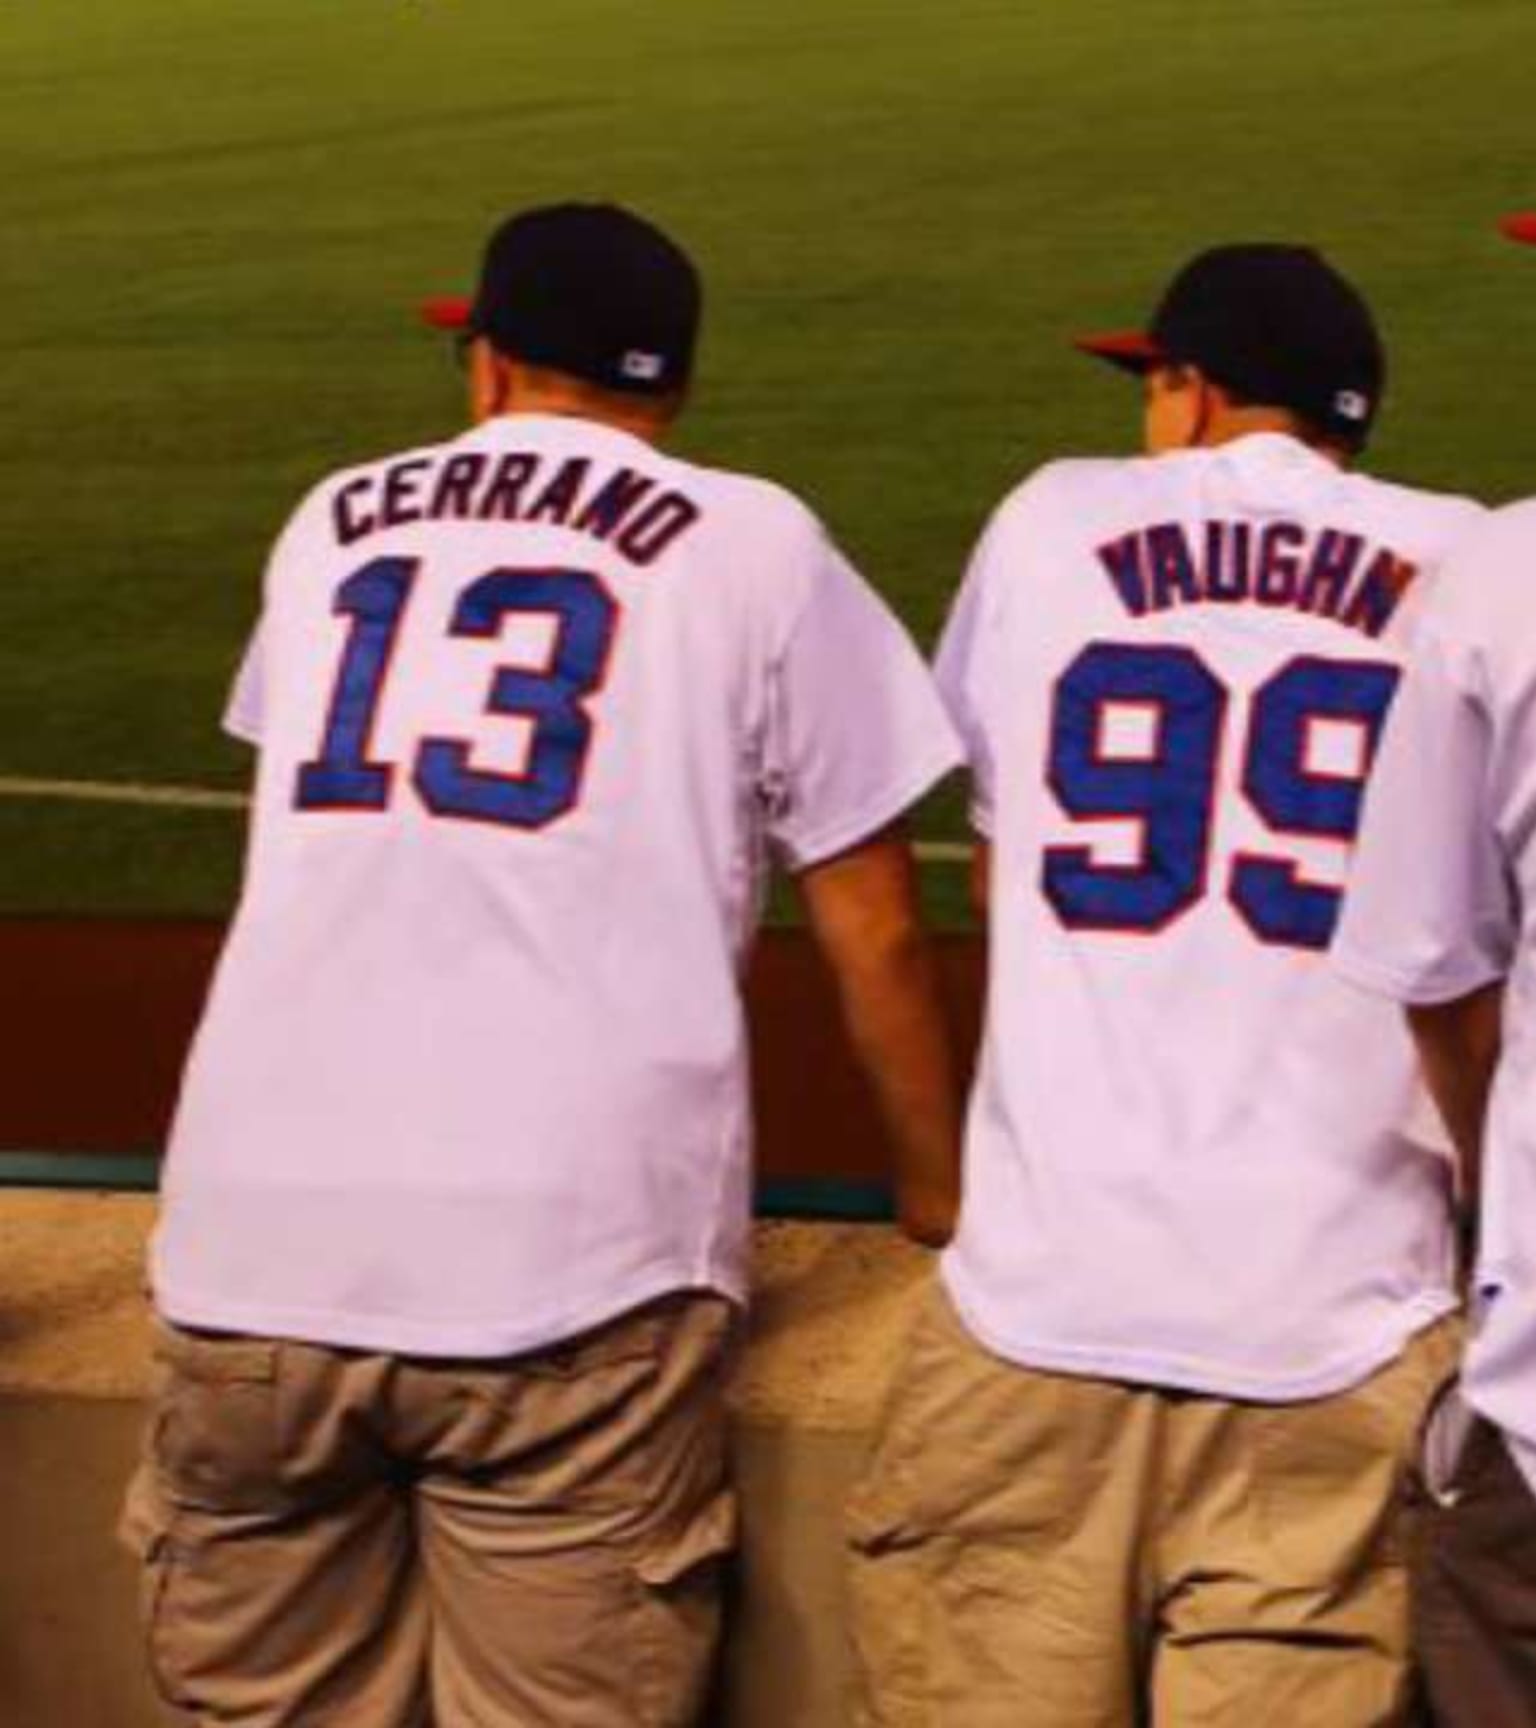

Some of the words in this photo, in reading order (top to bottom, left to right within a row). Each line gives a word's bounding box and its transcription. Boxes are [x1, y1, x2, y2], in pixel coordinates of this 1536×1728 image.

[331, 453, 701, 566] CERRANO
[1096, 519, 1418, 638] VAUGHN
[292, 556, 621, 830] 13
[1040, 641, 1404, 952] 99
